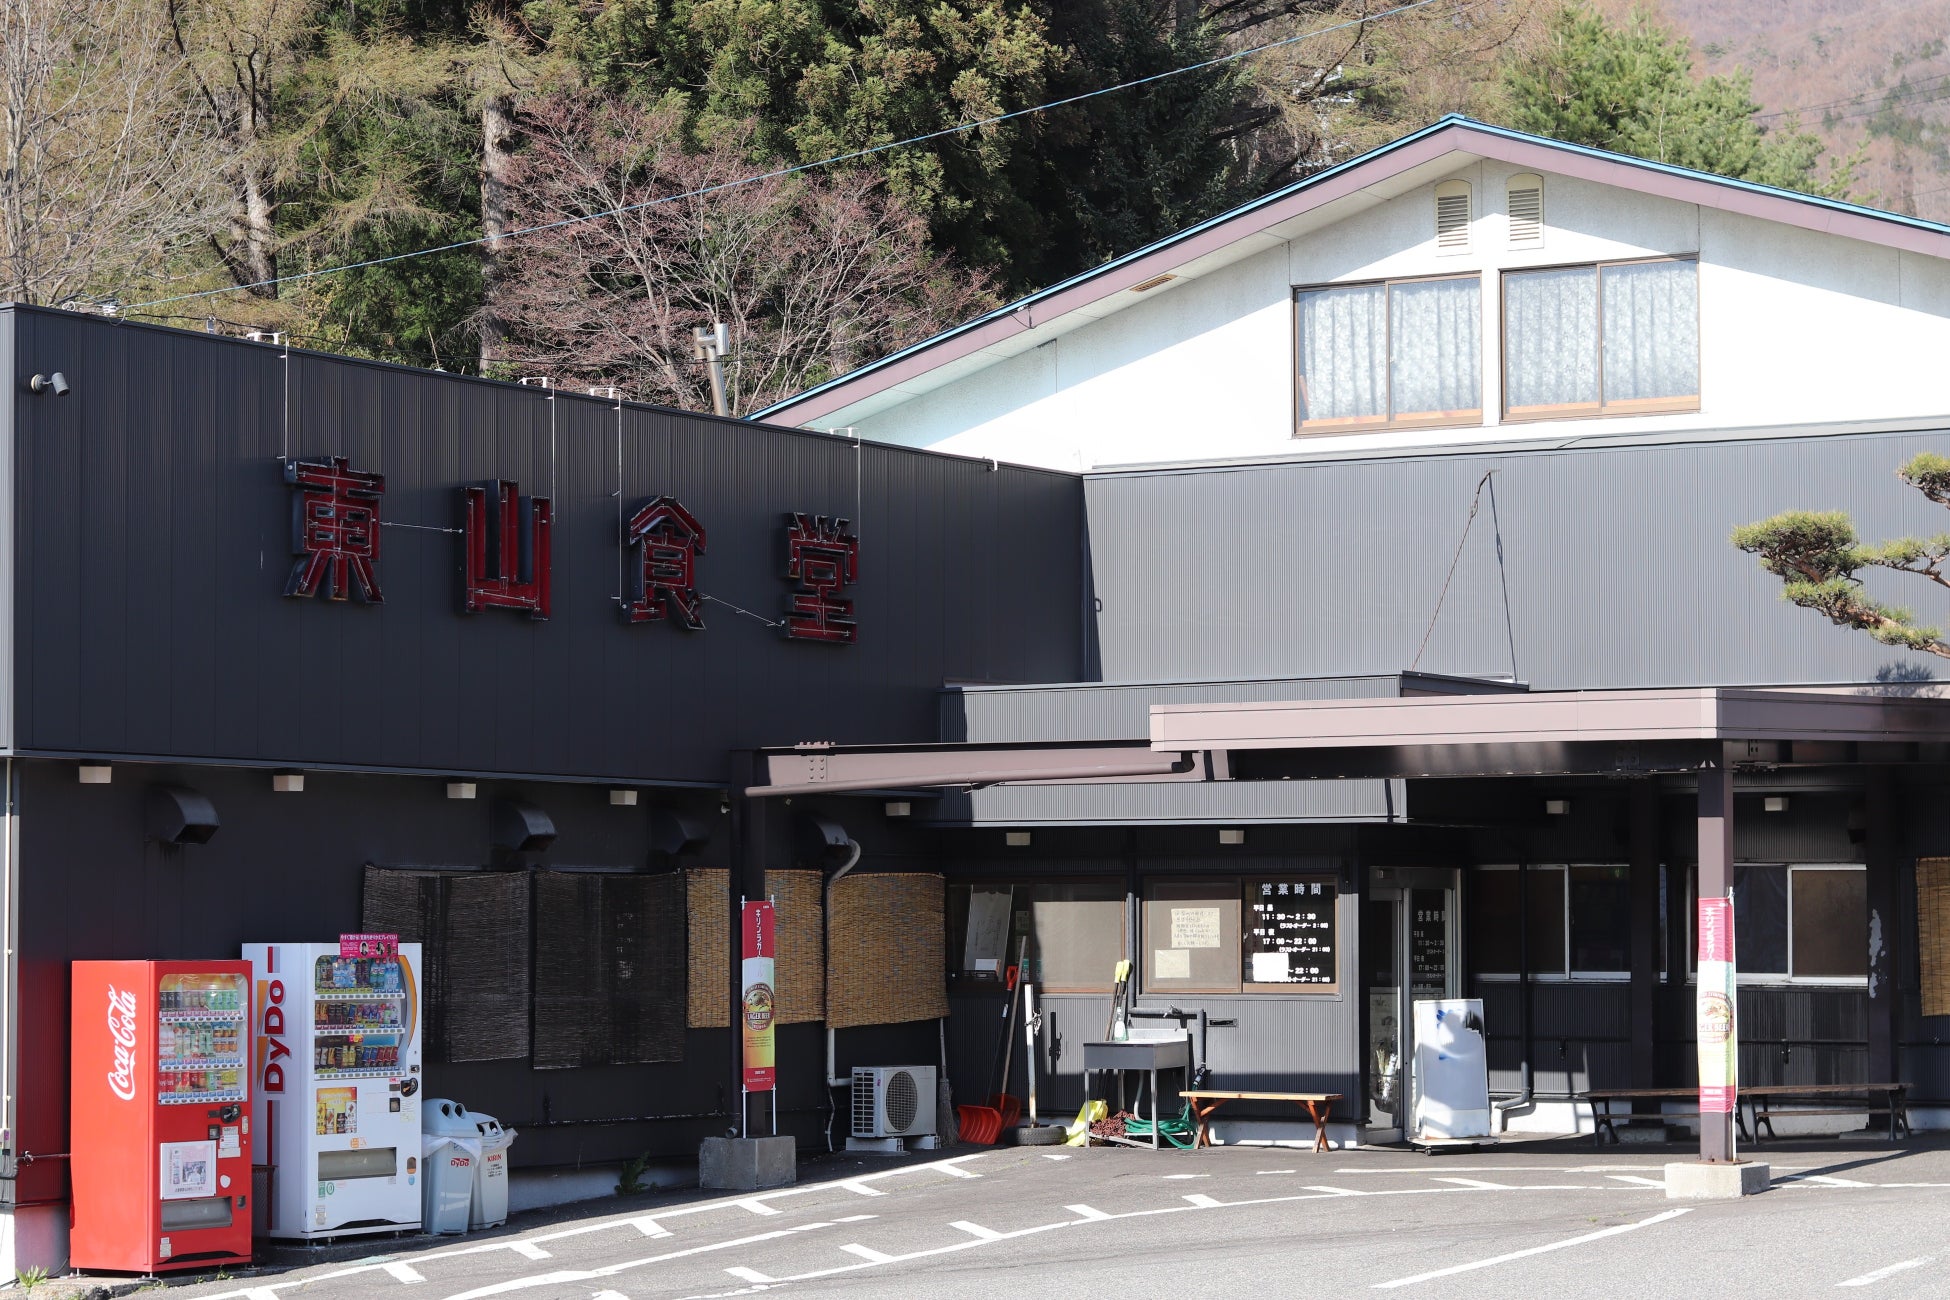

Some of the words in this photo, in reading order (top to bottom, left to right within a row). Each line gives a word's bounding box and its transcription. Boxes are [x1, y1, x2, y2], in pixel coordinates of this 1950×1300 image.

[1262, 883, 1321, 895] 営業時間
[264, 979, 290, 1092] DyDo
[487, 1153, 502, 1162] KIRIN
[450, 1159, 470, 1167] DyDo
